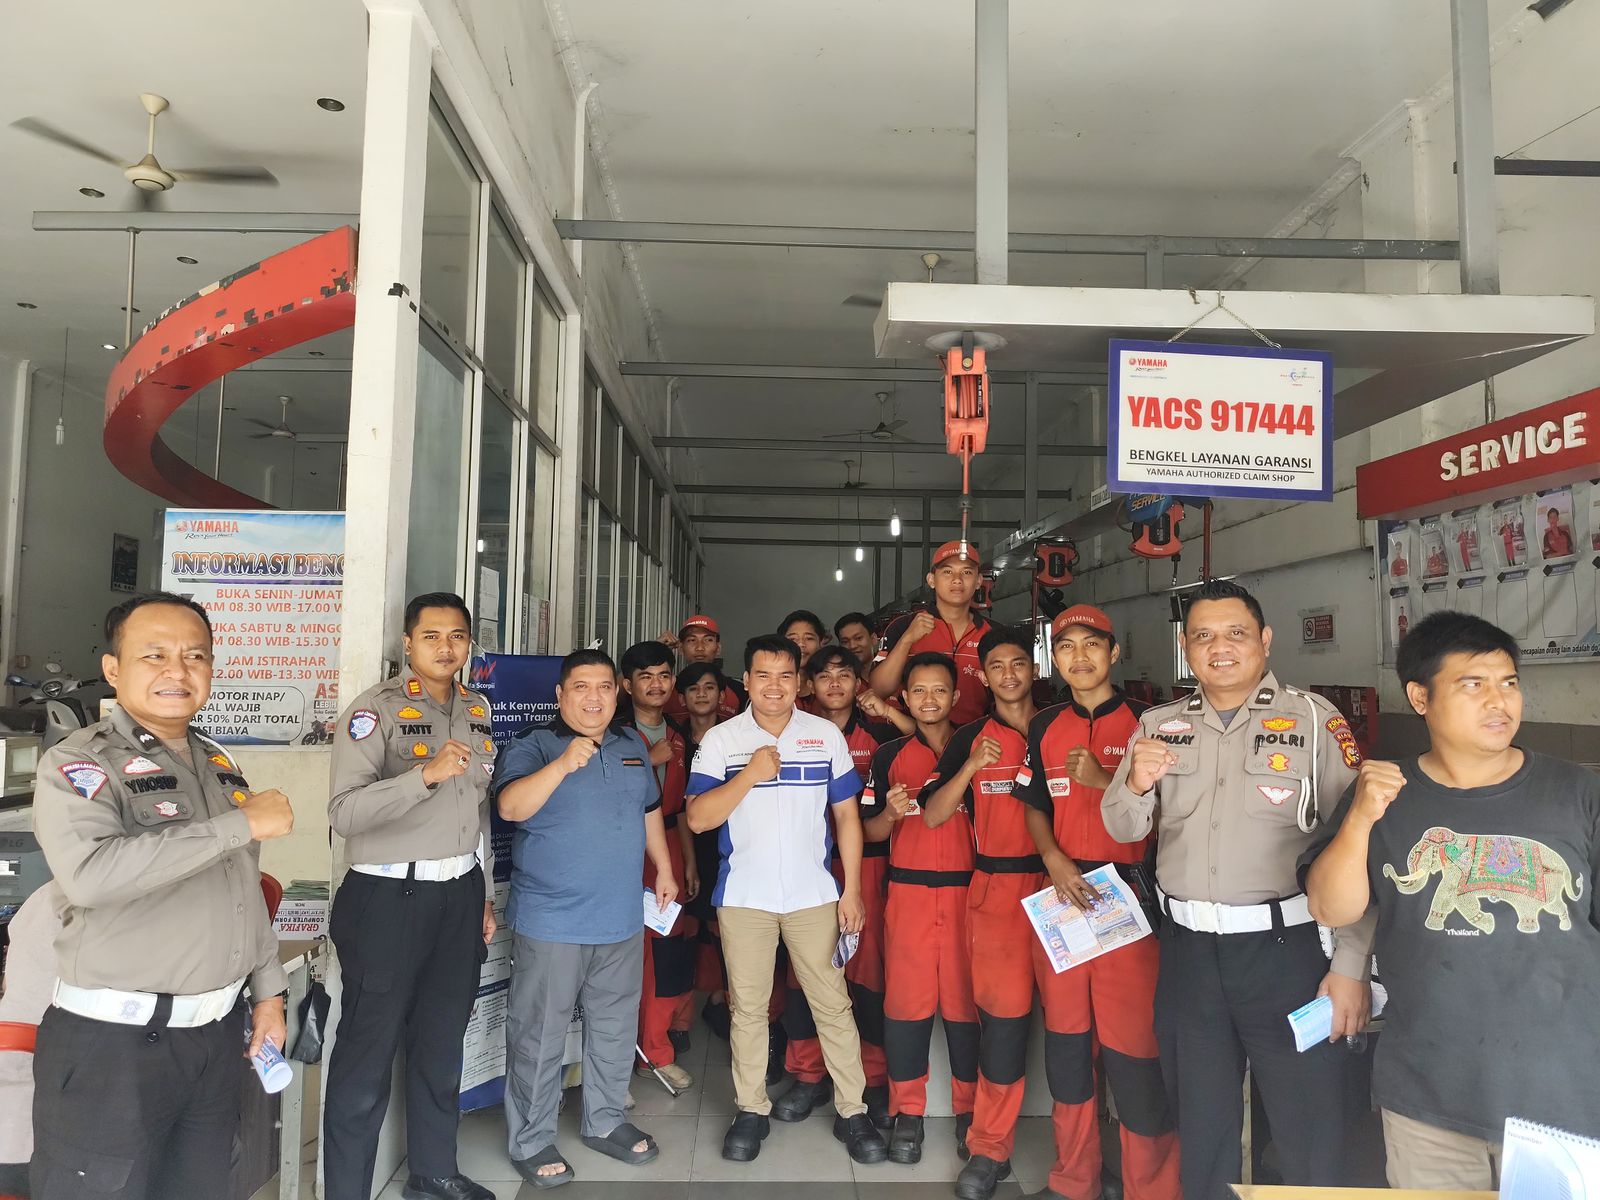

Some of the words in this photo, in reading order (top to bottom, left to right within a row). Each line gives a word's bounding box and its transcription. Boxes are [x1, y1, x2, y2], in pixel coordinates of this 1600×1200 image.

[1137, 358, 1168, 367] YAMAHA
[1128, 396, 1202, 430] YACS
[1211, 400, 1315, 436] 917444
[1440, 412, 1587, 481] SERVICE
[1129, 449, 1188, 463] BENGKEL
[1191, 452, 1250, 466] LAYANAN
[1254, 455, 1312, 469] GARANSI
[1146, 468, 1184, 477] YAMAHA
[1186, 470, 1241, 480] AUTHORIZED
[1243, 472, 1270, 481] CLAIM
[1272, 474, 1295, 483] SHOP
[190, 520, 239, 532] YAMAHA
[171, 552, 292, 577] INFORMASI
[216, 589, 250, 599] BUKA
[255, 589, 343, 599] SENIN-JUMAT
[229, 602, 262, 612] 08.30
[266, 603, 330, 612] WIB-17.00
[210, 623, 236, 632] UKA
[240, 623, 281, 633] SABTU
[286, 623, 296, 633] &
[212, 636, 224, 645] M
[228, 636, 262, 646] 08.30
[265, 637, 328, 646] WIB-15.30
[226, 656, 253, 666] JAM
[257, 656, 326, 666] ISTIRAHAR
[248, 670, 311, 680] WIB-13.30
[252, 692, 286, 702] INAP/
[225, 703, 261, 712] WAJIB
[207, 715, 230, 723] 50%
[234, 715, 261, 723] DARI
[265, 715, 300, 723] TOTAL
[215, 726, 249, 735] BIAYA
[1255, 733, 1304, 749] POLRI
[279, 923, 319, 932] GRAFIKA
[1445, 928, 1480, 936] Thailand
